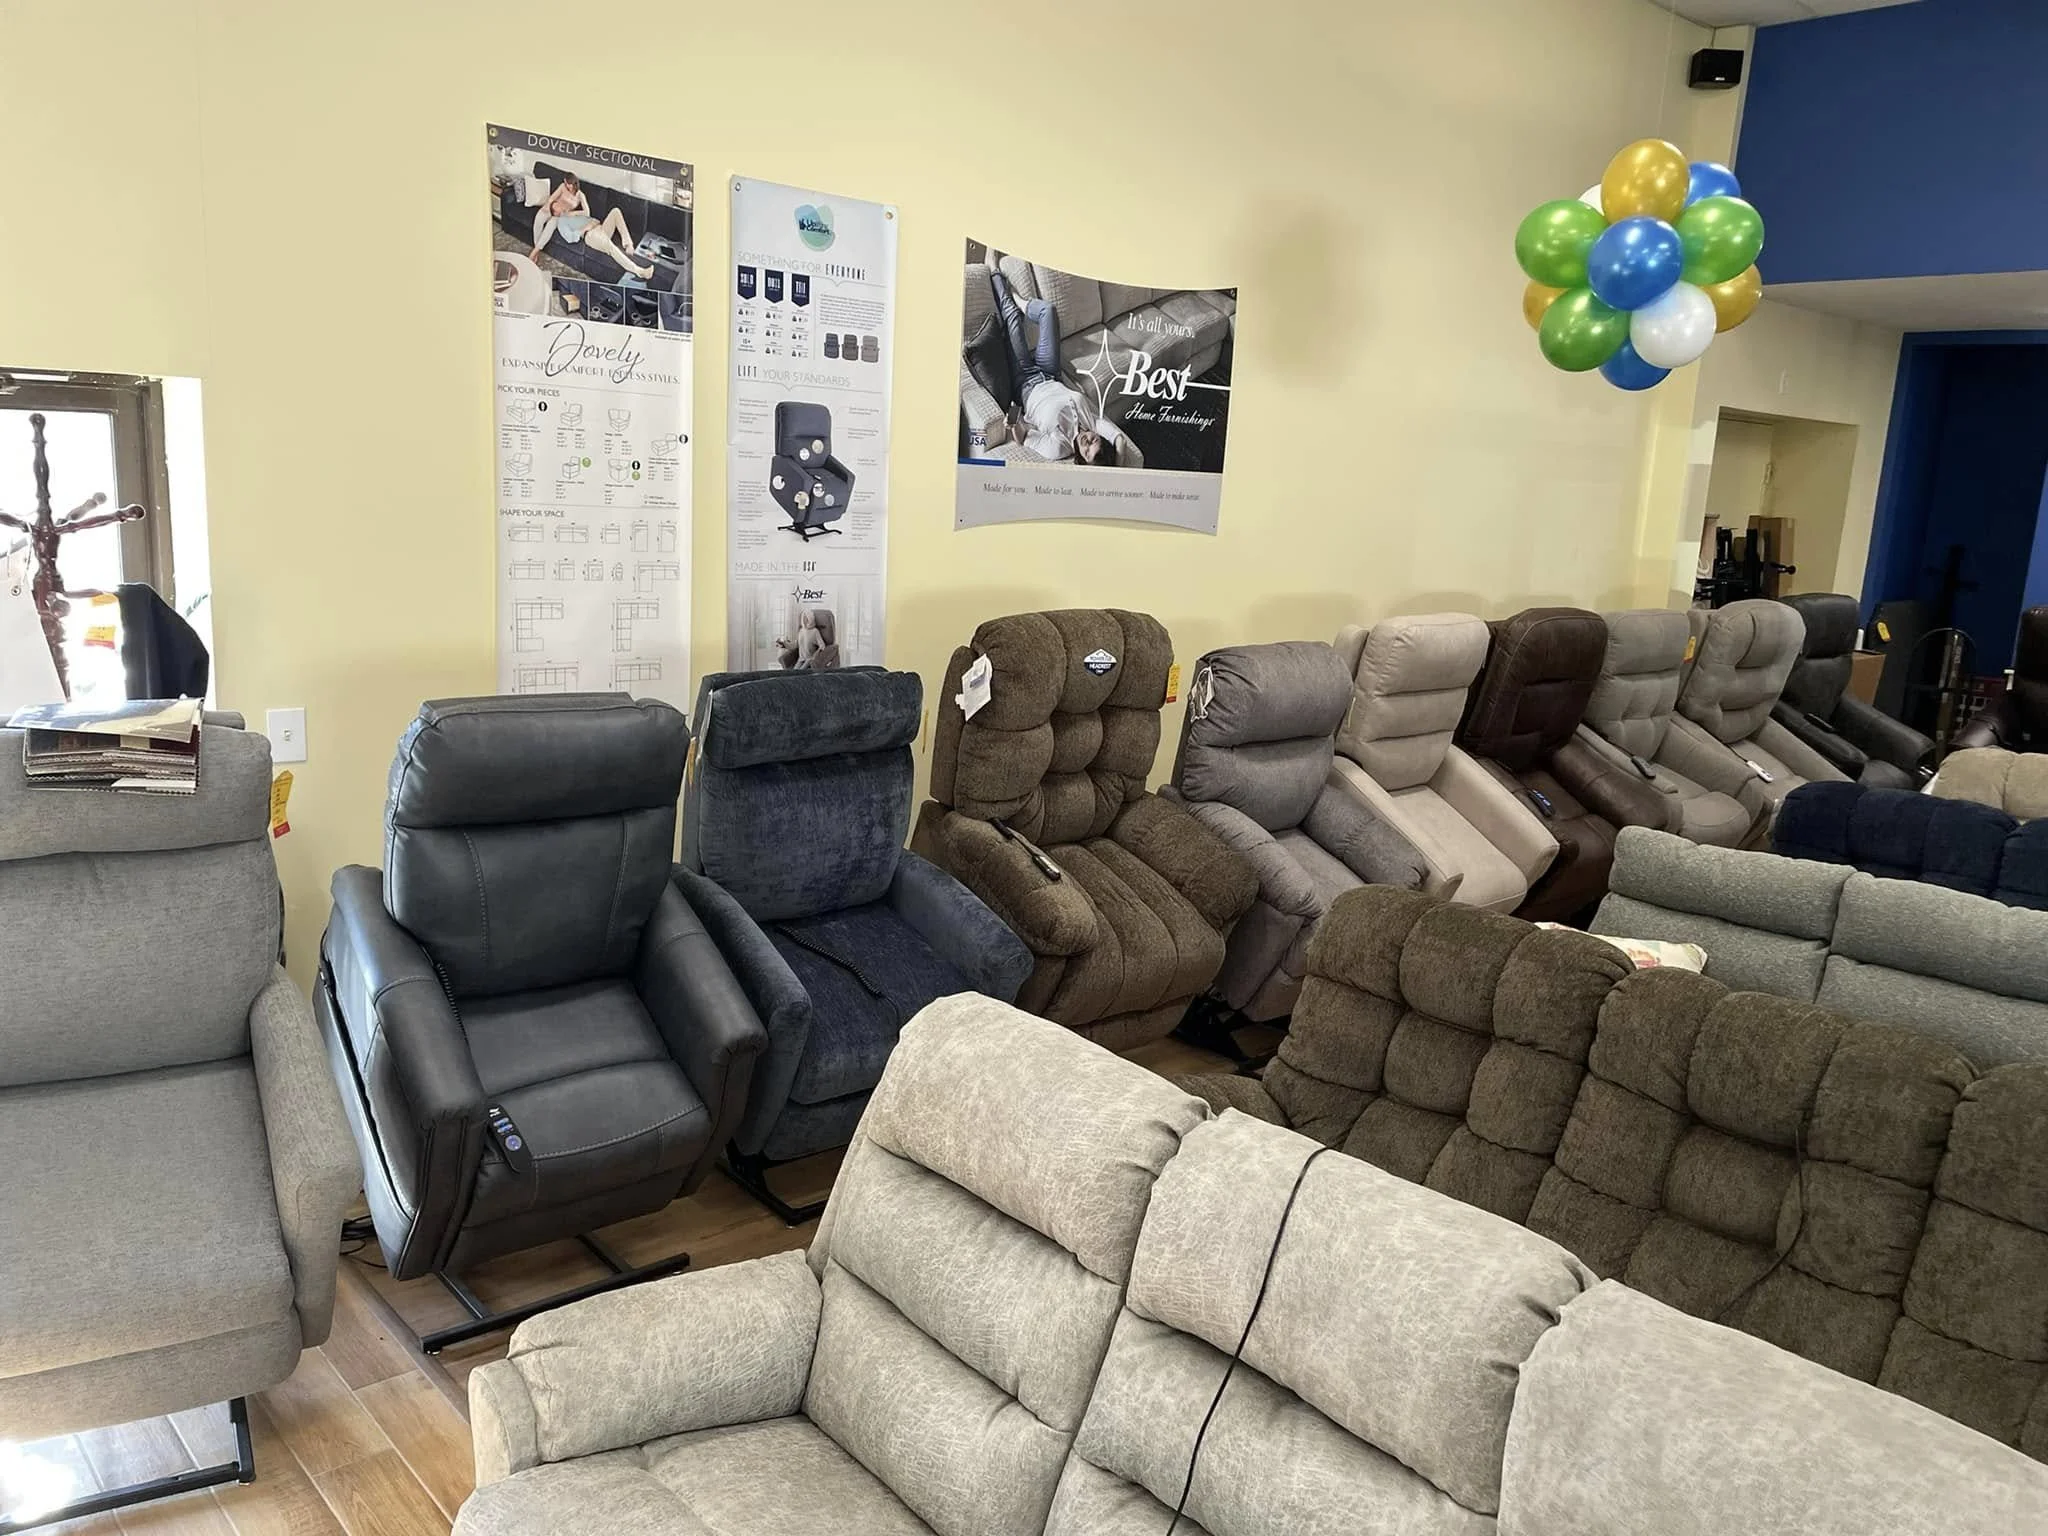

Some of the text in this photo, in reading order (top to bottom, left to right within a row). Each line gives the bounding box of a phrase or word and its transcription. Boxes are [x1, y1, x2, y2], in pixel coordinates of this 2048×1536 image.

[528, 134, 657, 172] DOVELY SECTIONAL
[737, 250, 866, 281] SOMETHING FOR EVERYONE
[1127, 312, 1196, 339] It's all yours.
[543, 321, 646, 384] Dovely
[737, 364, 851, 388] LIFT YOUR STANDARDS
[1119, 350, 1192, 402] Best
[498, 384, 560, 397] PICK YOUR PIECES
[1125, 402, 1216, 432] Home Furnishings
[983, 483, 1001, 492] Made
[1002, 484, 1012, 495] for
[1034, 485, 1052, 495] Made
[1079, 488, 1098, 497] Made
[500, 509, 521, 517] SHAPE
[544, 510, 565, 518] SPACE
[735, 562, 765, 572] MADE
[767, 562, 781, 572] IN
[782, 562, 801, 572] THE
[802, 589, 825, 600] Best
